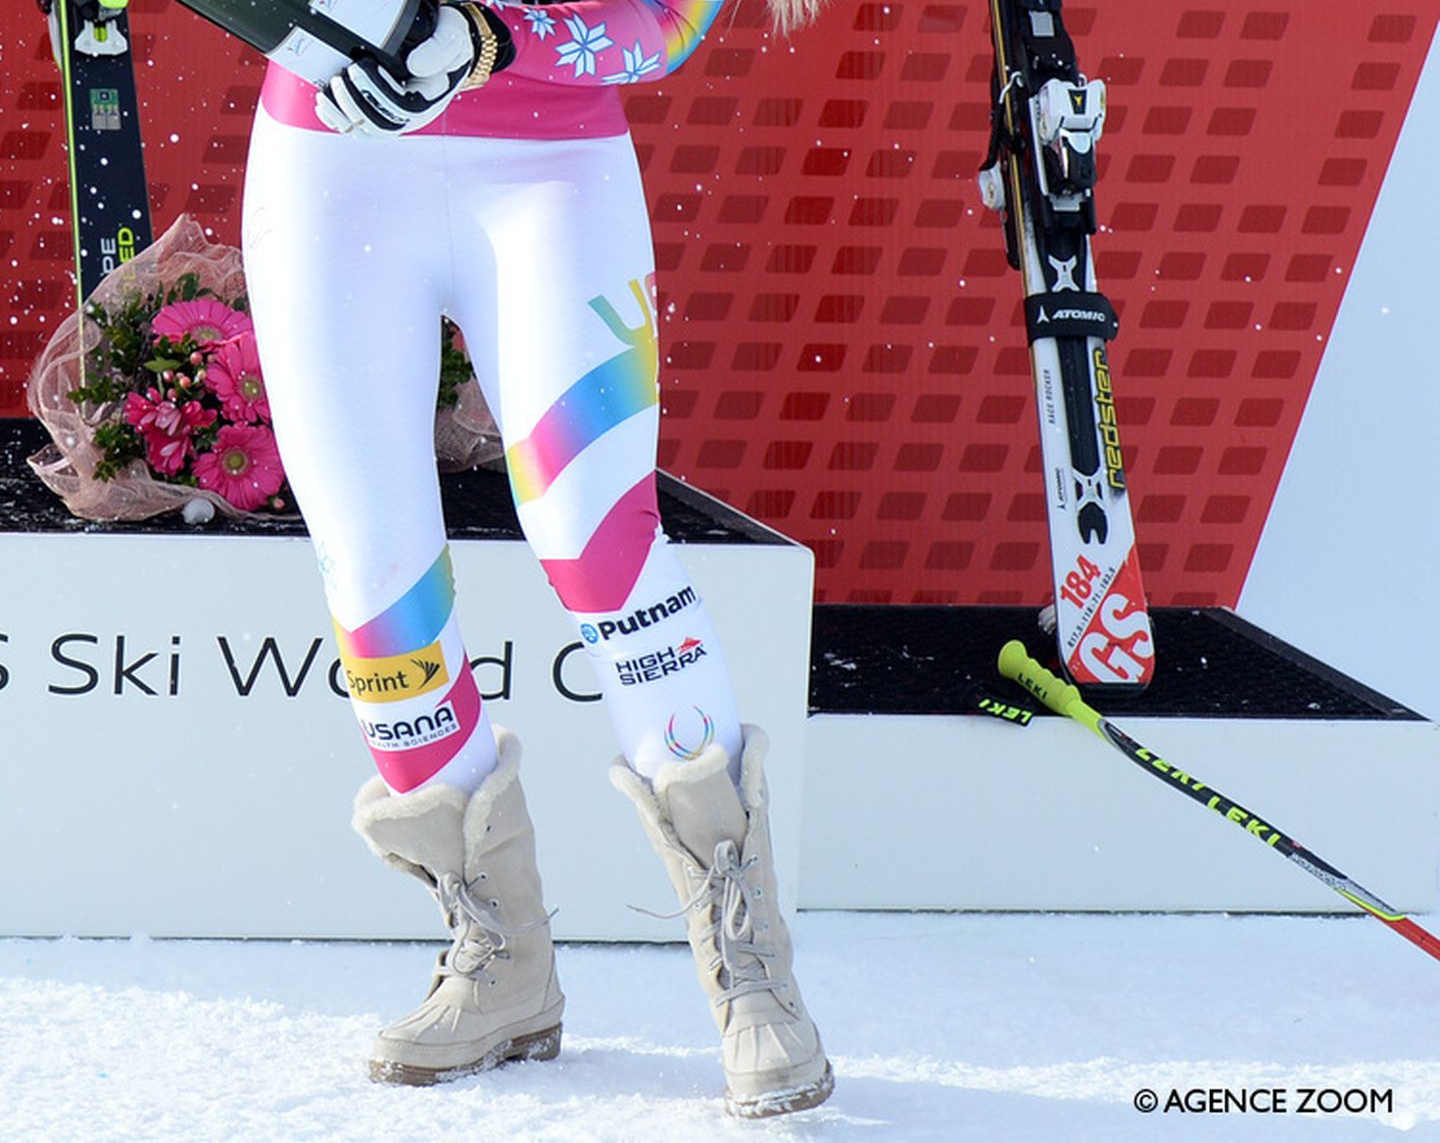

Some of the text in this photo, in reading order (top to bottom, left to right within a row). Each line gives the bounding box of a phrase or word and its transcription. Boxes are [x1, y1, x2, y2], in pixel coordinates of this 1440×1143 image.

[1052, 308, 1106, 323] ATOMIC
[1092, 347, 1126, 490] redster
[1060, 554, 1101, 609] 184
[597, 585, 697, 641] Putnam
[615, 646, 676, 674] HIGH
[1078, 593, 1156, 684] GS
[48, 633, 181, 697] Ski
[619, 645, 708, 686] SIERRA
[1016, 671, 1049, 701] LEKI
[360, 705, 454, 741] USANA
[978, 698, 1034, 724] LEKI
[1135, 746, 1282, 848] LEKI LEKI
